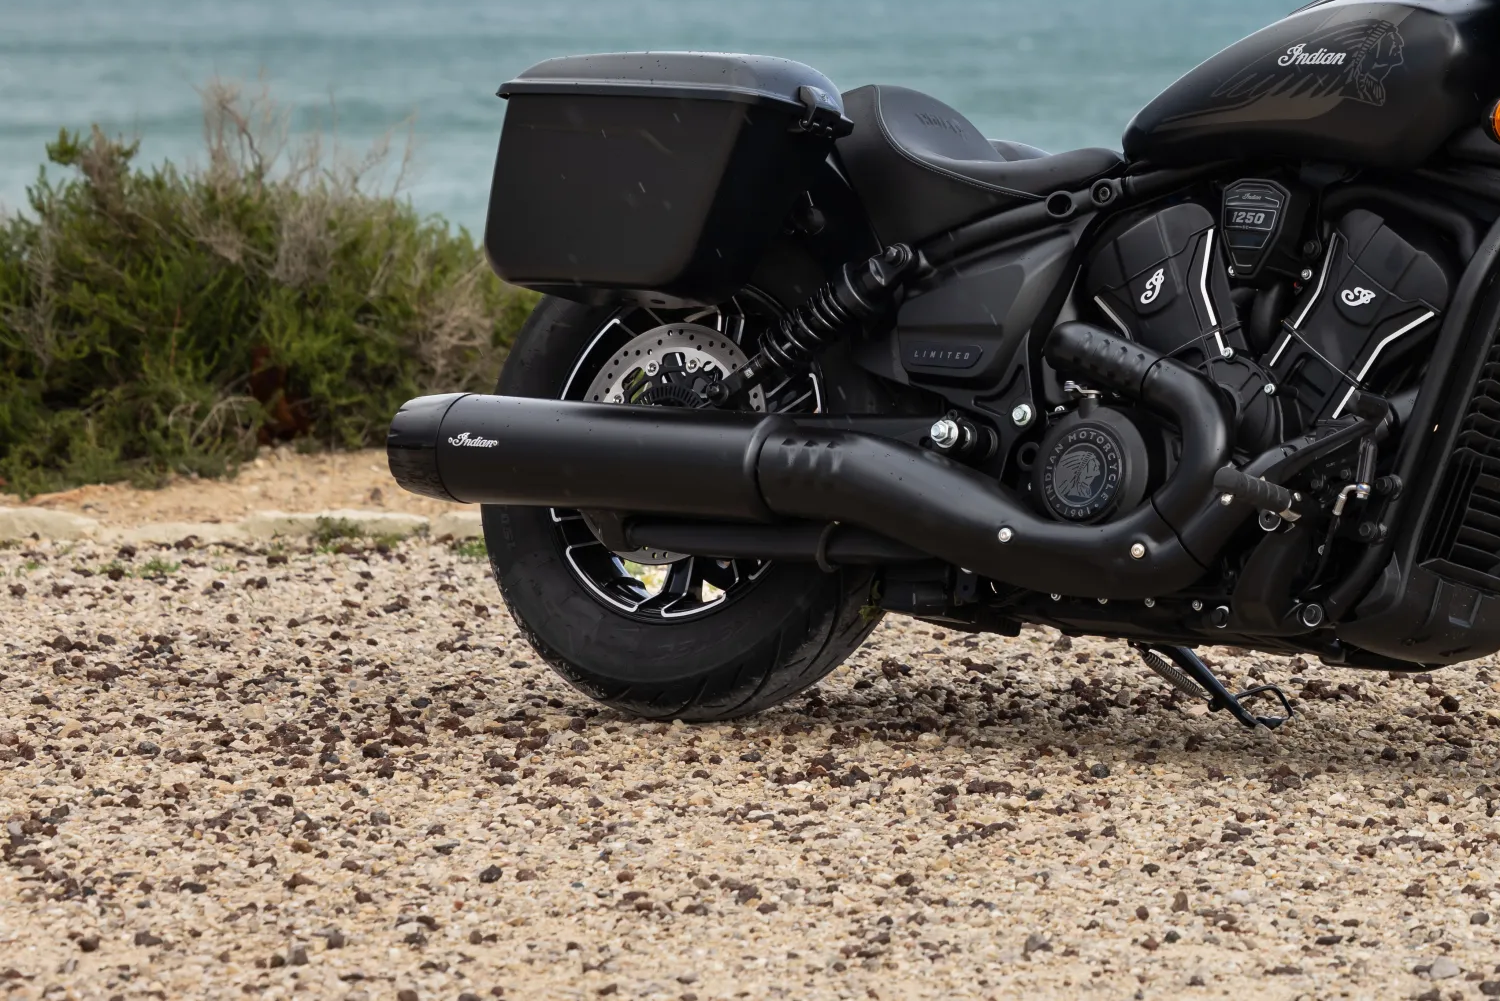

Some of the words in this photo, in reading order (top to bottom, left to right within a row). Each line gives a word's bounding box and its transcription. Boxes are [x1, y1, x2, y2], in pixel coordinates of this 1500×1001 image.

[1277, 43, 1347, 67] Indian
[1231, 211, 1266, 225] 1250
[913, 350, 970, 360] LIMITED
[448, 432, 498, 448] Indian
[1044, 443, 1064, 501] INDIAN
[1068, 430, 1118, 501] MOTORCYCLE
[1063, 506, 1092, 518] 1901
